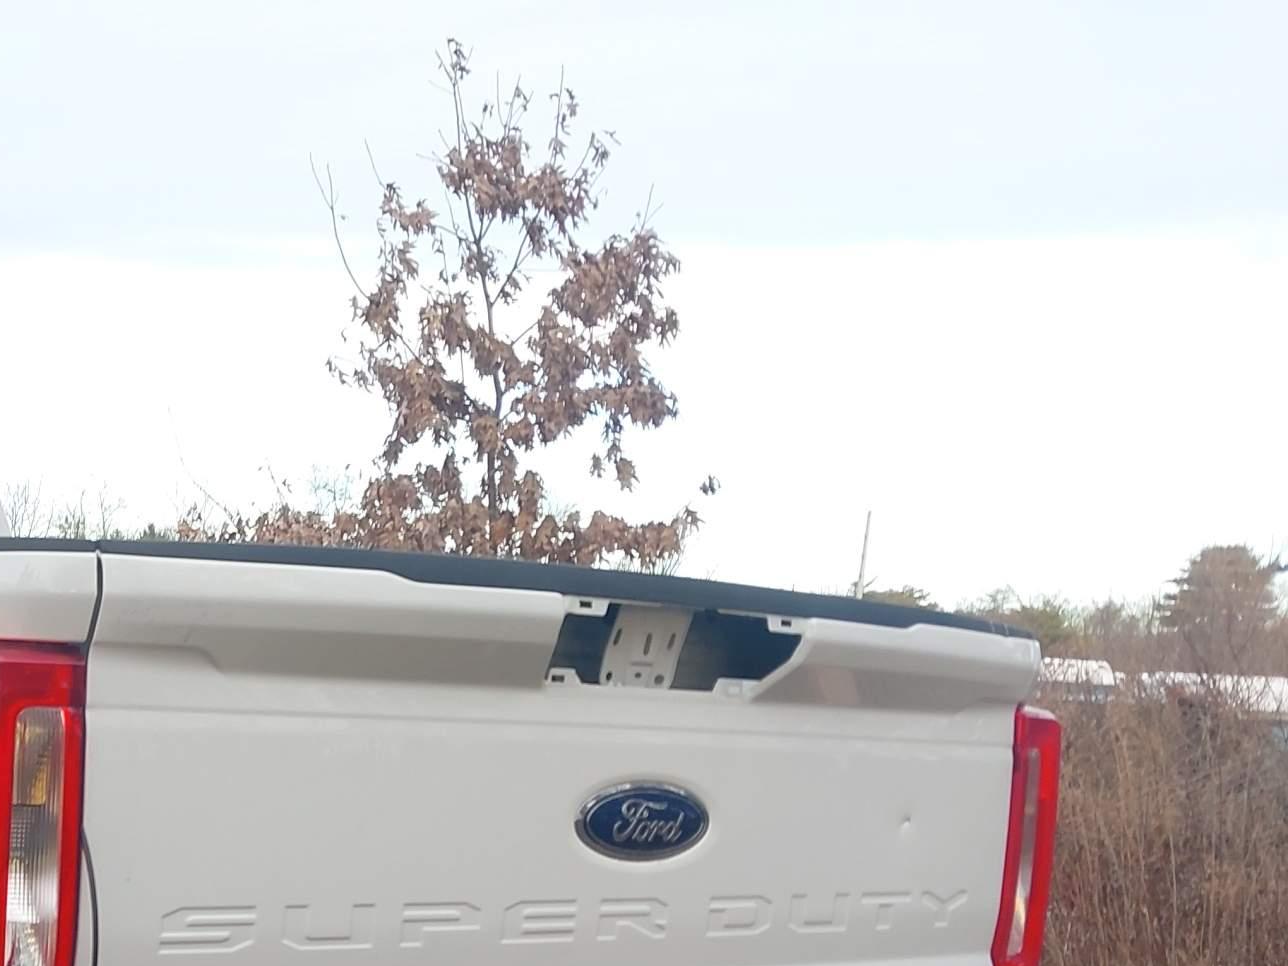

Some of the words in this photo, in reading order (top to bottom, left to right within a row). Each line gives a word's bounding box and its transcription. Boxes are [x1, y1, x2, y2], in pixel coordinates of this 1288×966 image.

[613, 798, 684, 842] Ford
[158, 898, 668, 955] SUPER
[705, 889, 967, 937] DUTY
